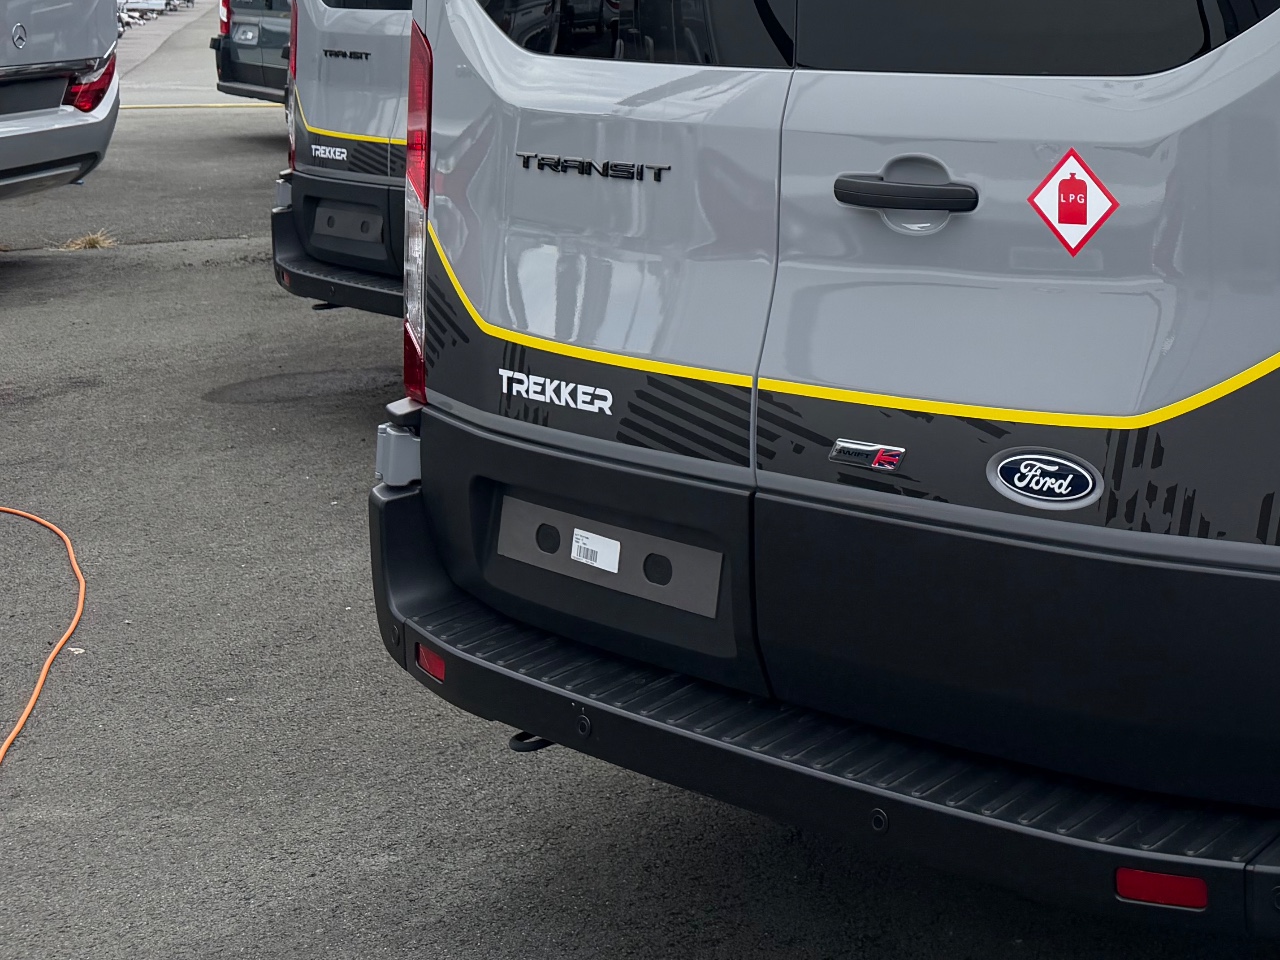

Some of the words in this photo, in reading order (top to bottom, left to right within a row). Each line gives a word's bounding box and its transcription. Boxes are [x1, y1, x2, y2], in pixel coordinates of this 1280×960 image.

[322, 49, 372, 61] TRANSIT
[311, 144, 348, 161] TREKKER
[515, 151, 672, 183] TRANSIT
[1060, 193, 1086, 204] LPG
[498, 368, 613, 416] TREKKER
[835, 447, 872, 459] SWIFT
[1013, 460, 1074, 495] Ford
